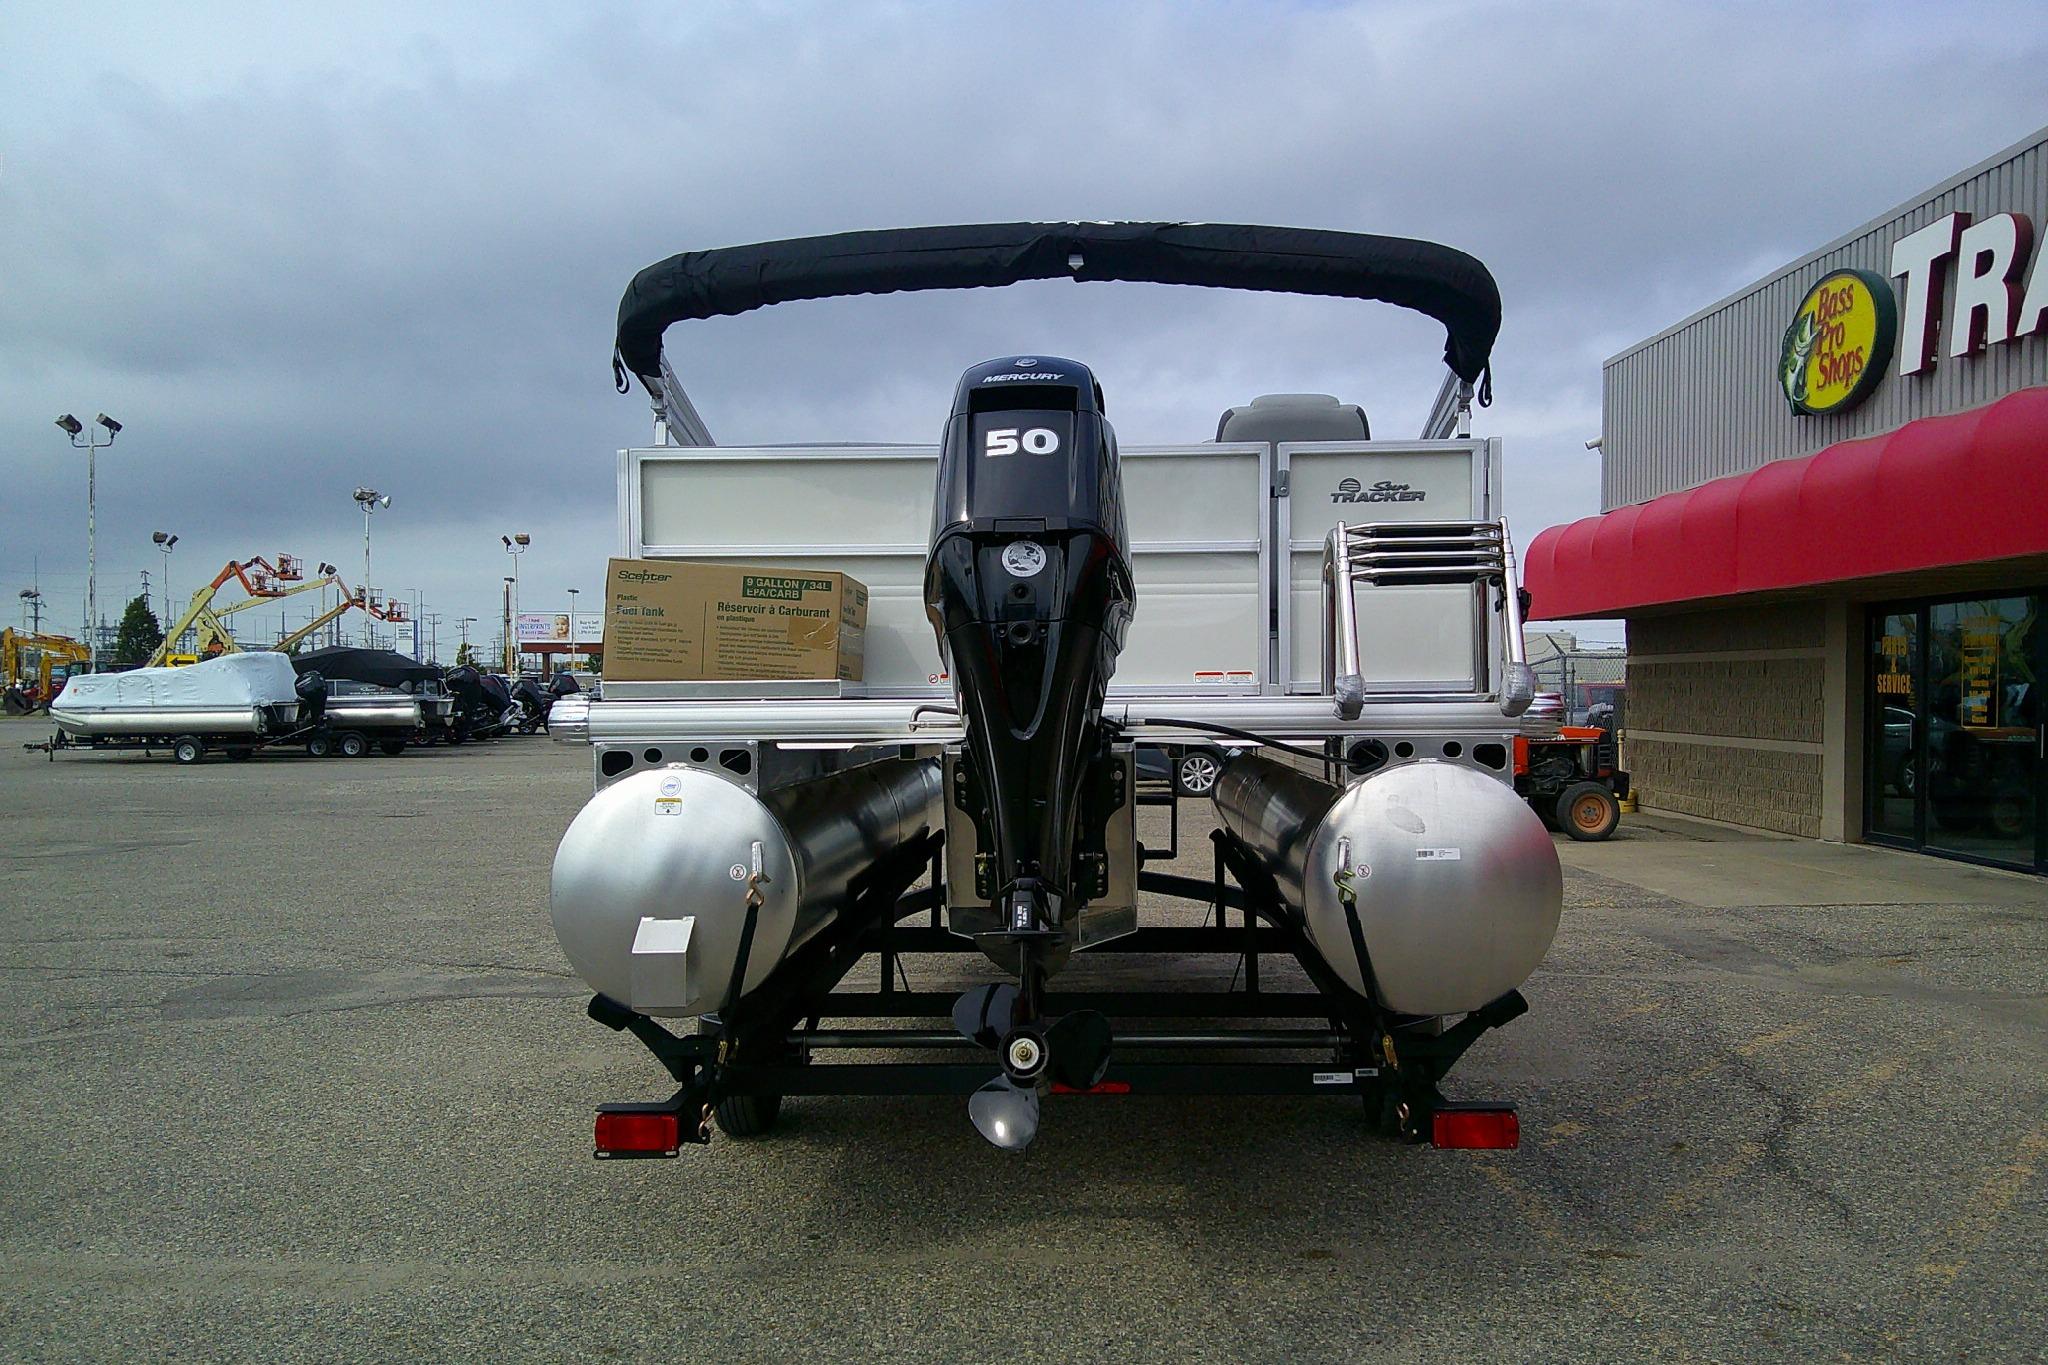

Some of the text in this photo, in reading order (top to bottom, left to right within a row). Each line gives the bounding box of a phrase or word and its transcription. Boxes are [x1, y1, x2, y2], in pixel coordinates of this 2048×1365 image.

[1816, 284, 1854, 324] Bass
[1816, 321, 1846, 354] Pro
[1816, 346, 1864, 391] Shops
[982, 373, 1065, 383] MERCURY
[986, 428, 1060, 457] 50
[1368, 481, 1410, 491] Sun
[1330, 491, 1426, 503] TRACKER
[618, 569, 672, 584] Scepter
[746, 578, 754, 586] 9
[756, 578, 800, 588] GALLON
[809, 581, 829, 590] 34L
[746, 588, 800, 599] EPA/CARB
[641, 606, 665, 617] Tank
[717, 602, 831, 618] Réservoir à Carburant
[1877, 674, 1911, 694] SERVICE
